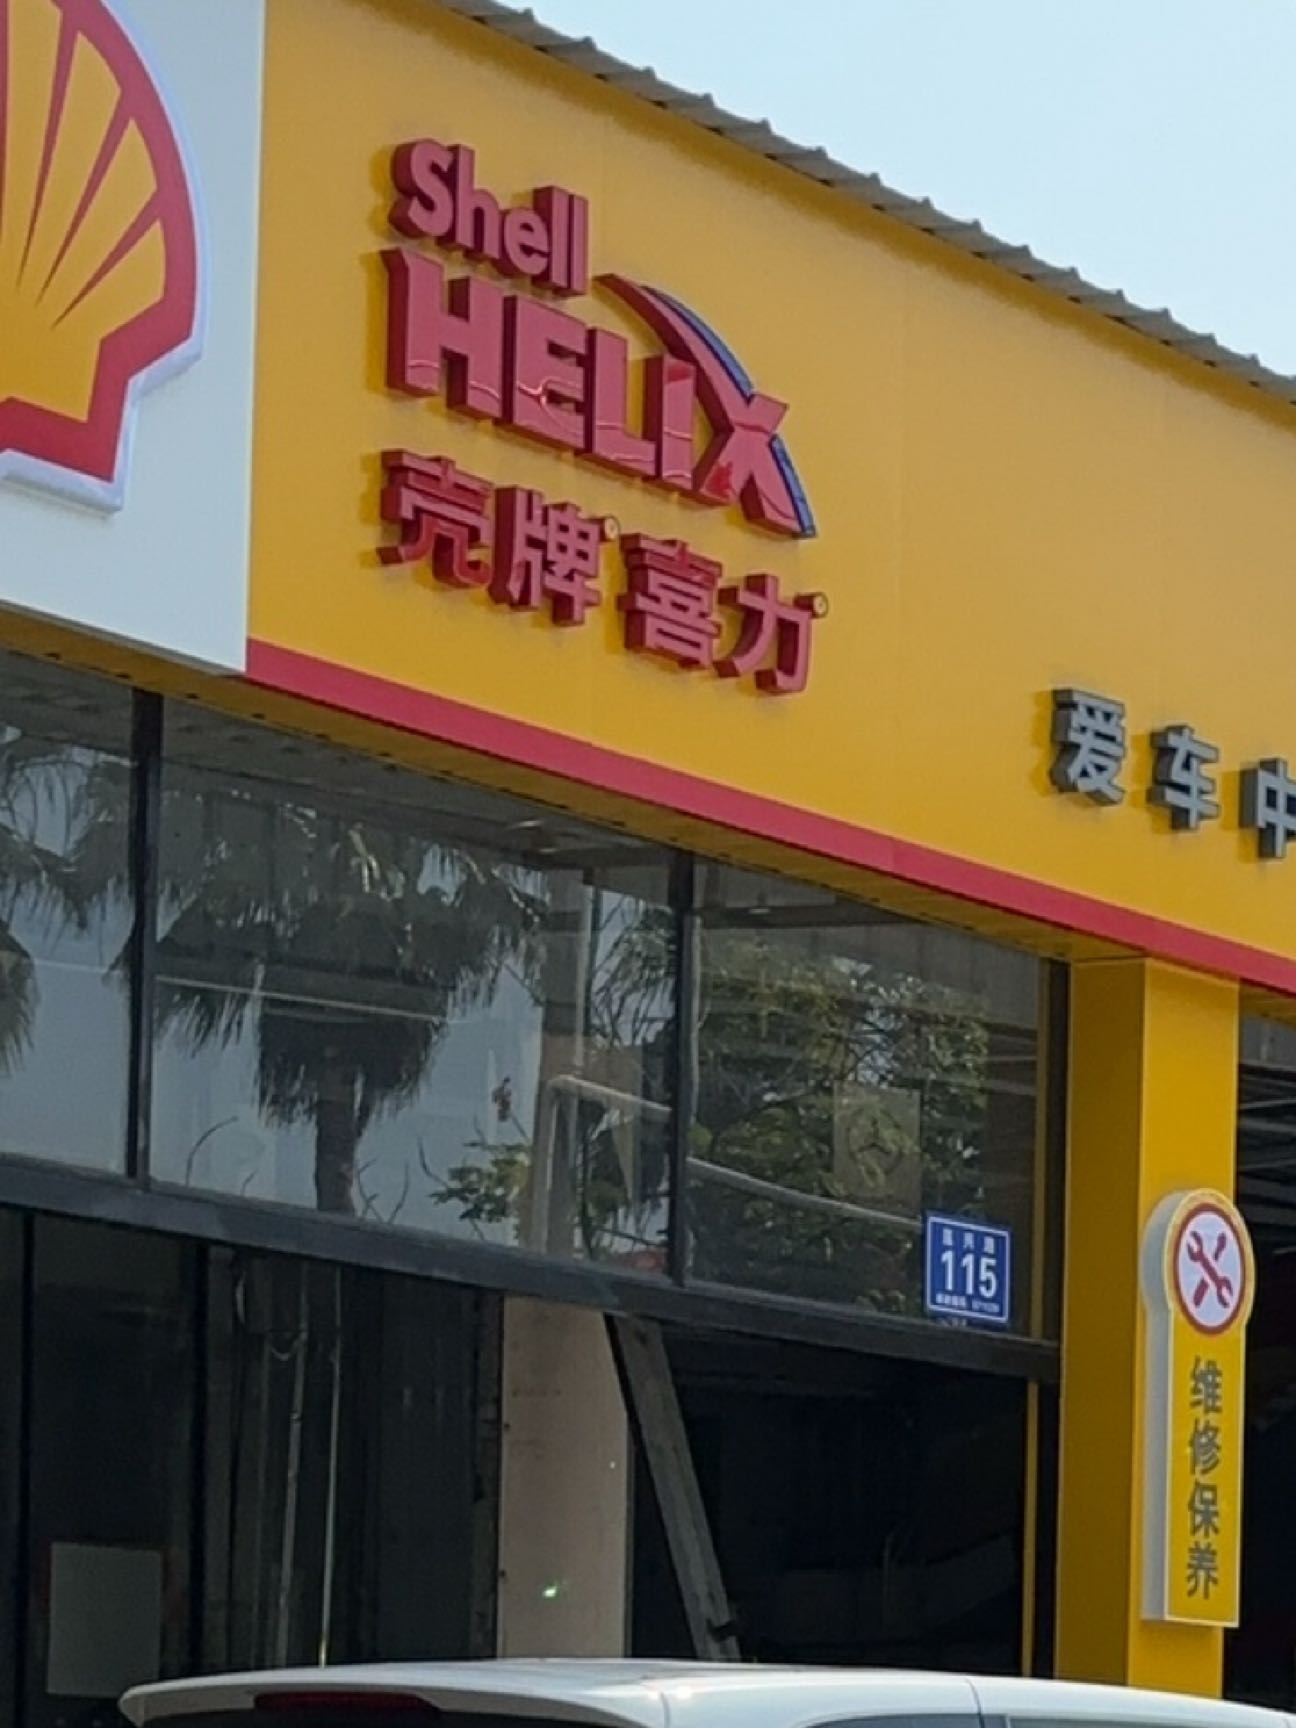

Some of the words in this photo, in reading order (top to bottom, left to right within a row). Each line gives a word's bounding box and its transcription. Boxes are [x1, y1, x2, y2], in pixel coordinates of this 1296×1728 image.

[389, 138, 588, 296] Shell
[380, 248, 817, 538] HELIX
[941, 1250, 997, 1298] 115
[1187, 1356, 1222, 1599] 维修保养
